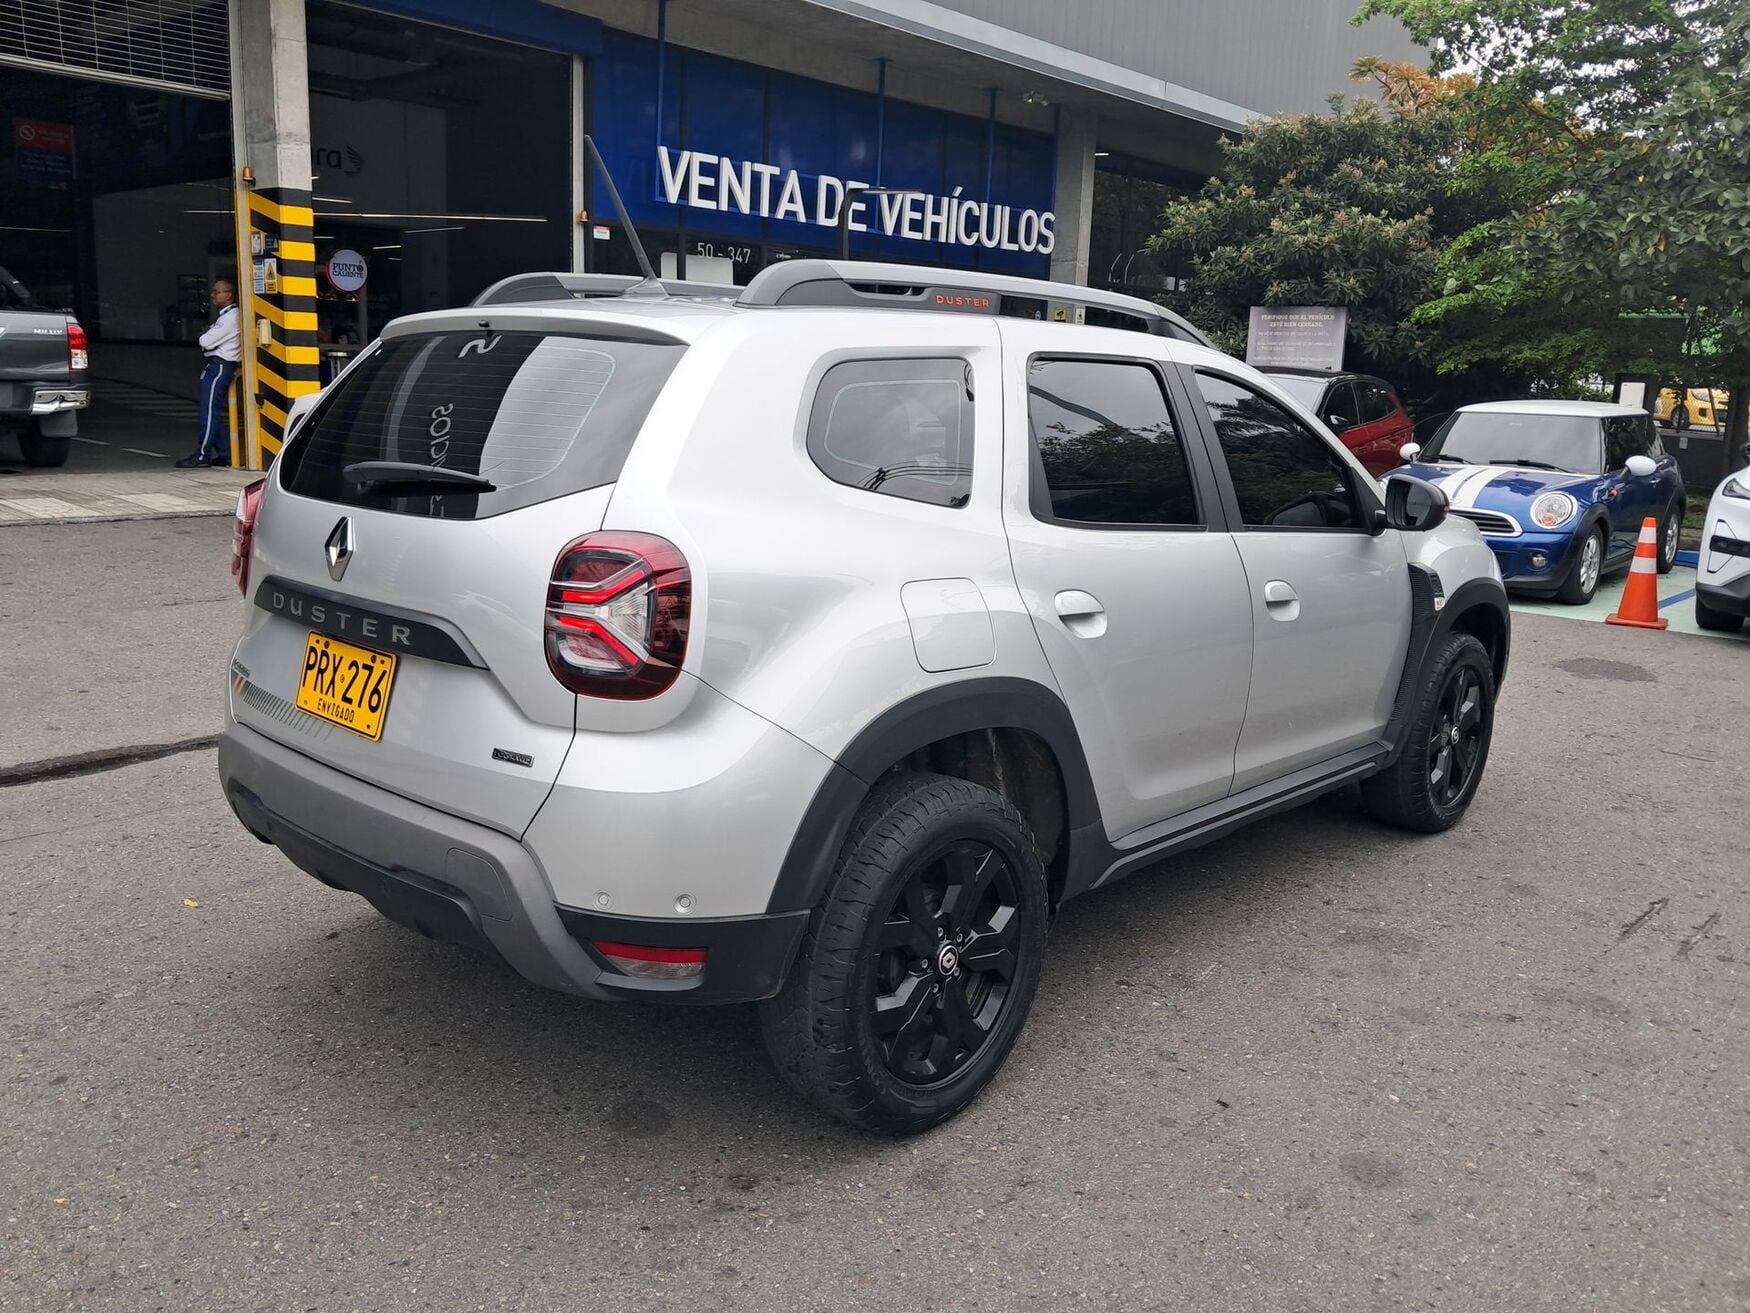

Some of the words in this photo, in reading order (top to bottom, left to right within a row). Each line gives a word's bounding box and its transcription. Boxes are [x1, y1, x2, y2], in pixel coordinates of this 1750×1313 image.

[657, 145, 806, 223] VENTA
[815, 174, 870, 232] DE
[879, 186, 1056, 255] VEHÍCULOS
[697, 242, 713, 259] 50
[727, 246, 751, 264] 347
[332, 262, 364, 273] PUNTO
[936, 294, 990, 307] DUSTER
[33, 327, 64, 336] HILUX
[272, 591, 411, 646] DUSTER
[317, 698, 355, 723] ENVIGADO
